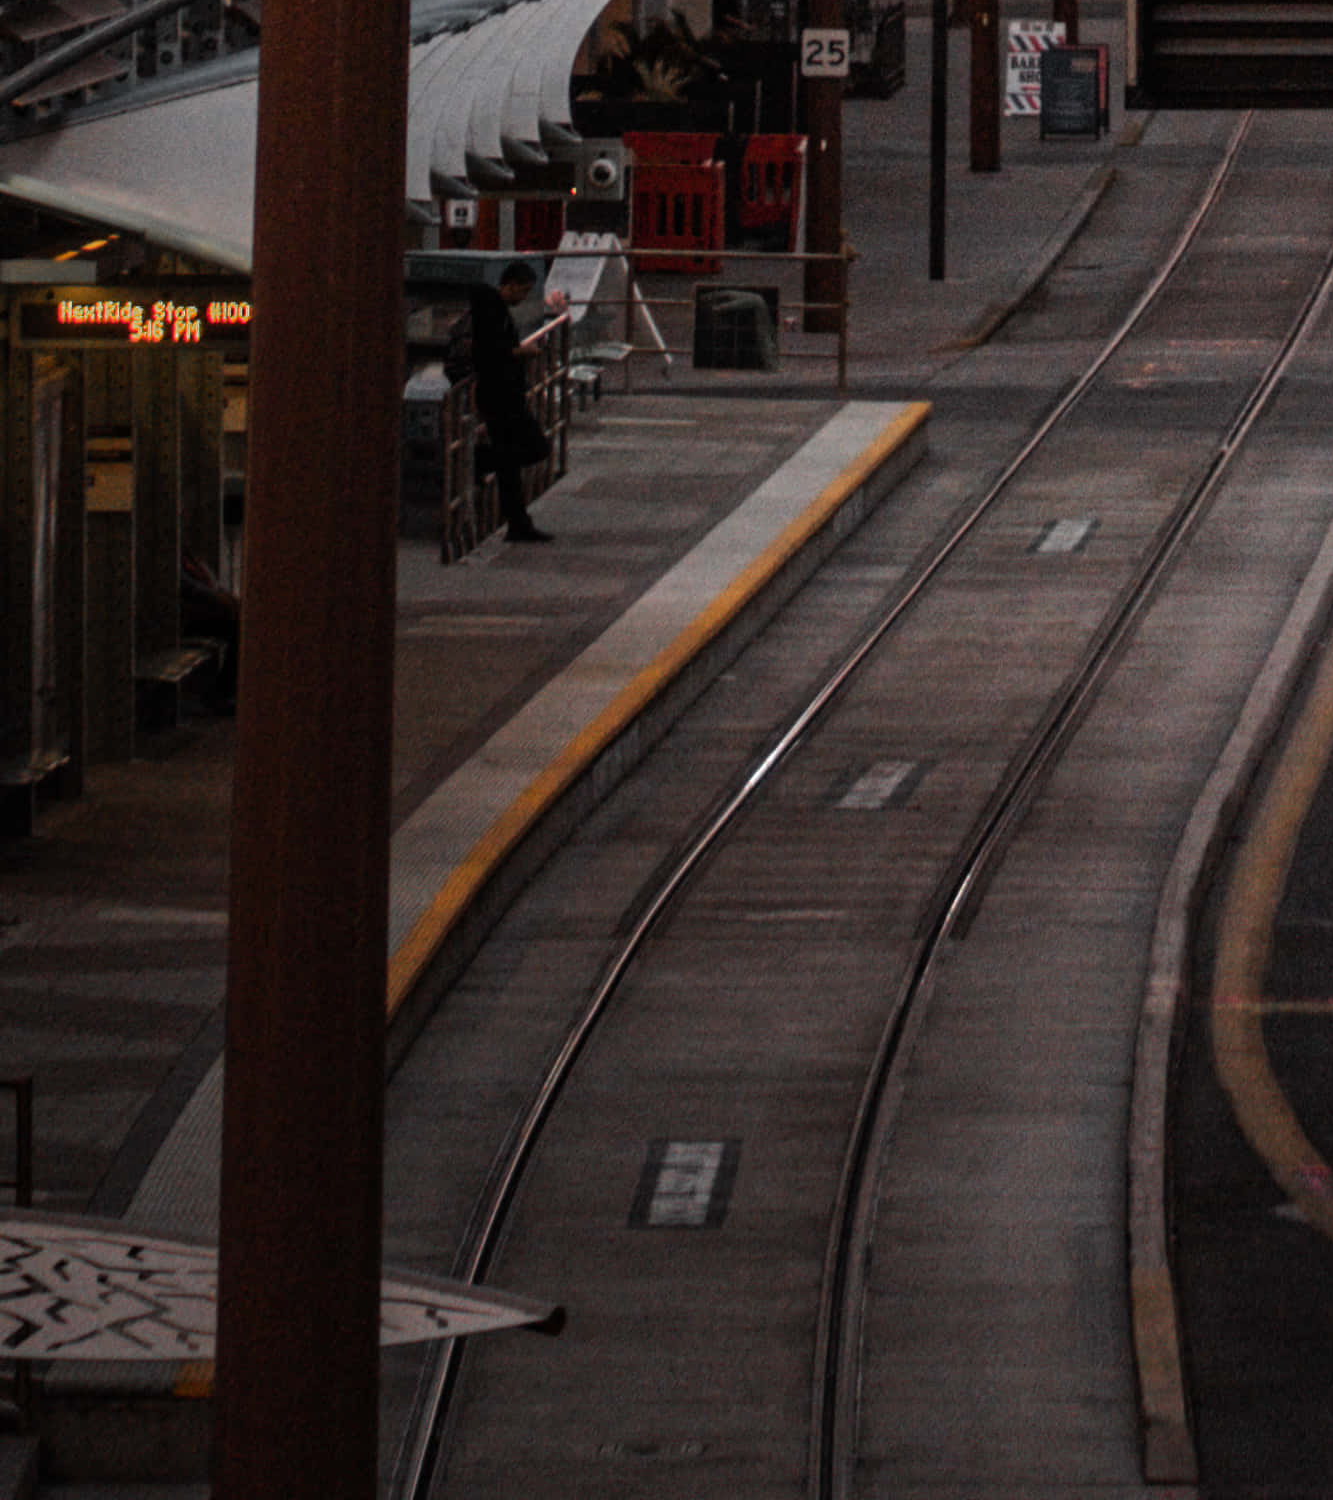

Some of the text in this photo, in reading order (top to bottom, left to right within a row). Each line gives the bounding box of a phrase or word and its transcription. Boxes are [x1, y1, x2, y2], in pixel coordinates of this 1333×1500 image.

[806, 39, 845, 66] 25
[152, 301, 198, 323] Stop
[172, 319, 201, 342] PM
